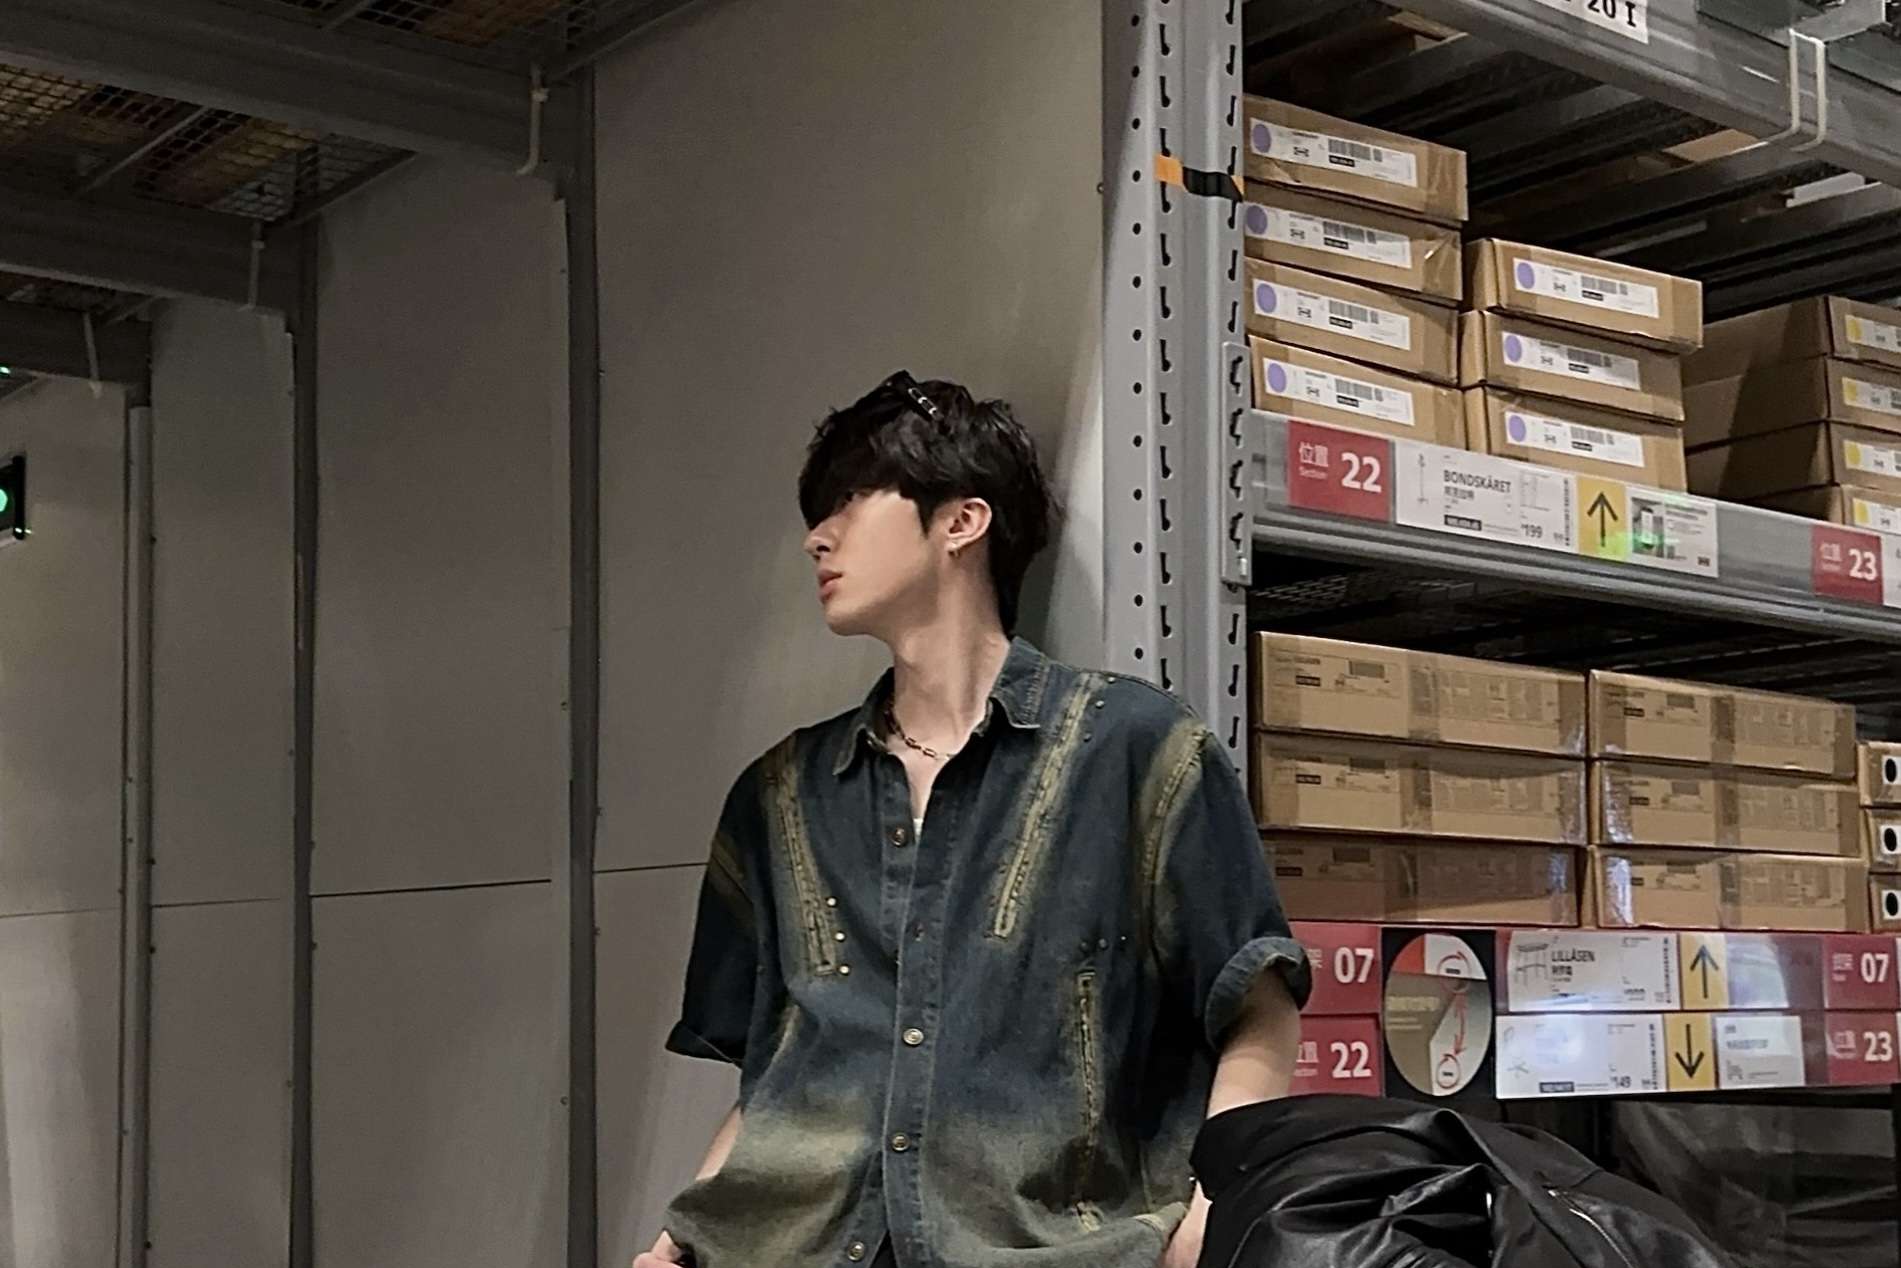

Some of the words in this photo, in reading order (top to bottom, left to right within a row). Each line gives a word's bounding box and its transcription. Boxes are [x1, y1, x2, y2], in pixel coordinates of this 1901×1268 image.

[1341, 452, 1382, 493] 22
[1848, 548, 1877, 581] 23
[1334, 947, 1374, 983] 07
[1861, 952, 1889, 983] 07
[1331, 1041, 1372, 1078] 22
[1864, 1031, 1893, 1062] 23
